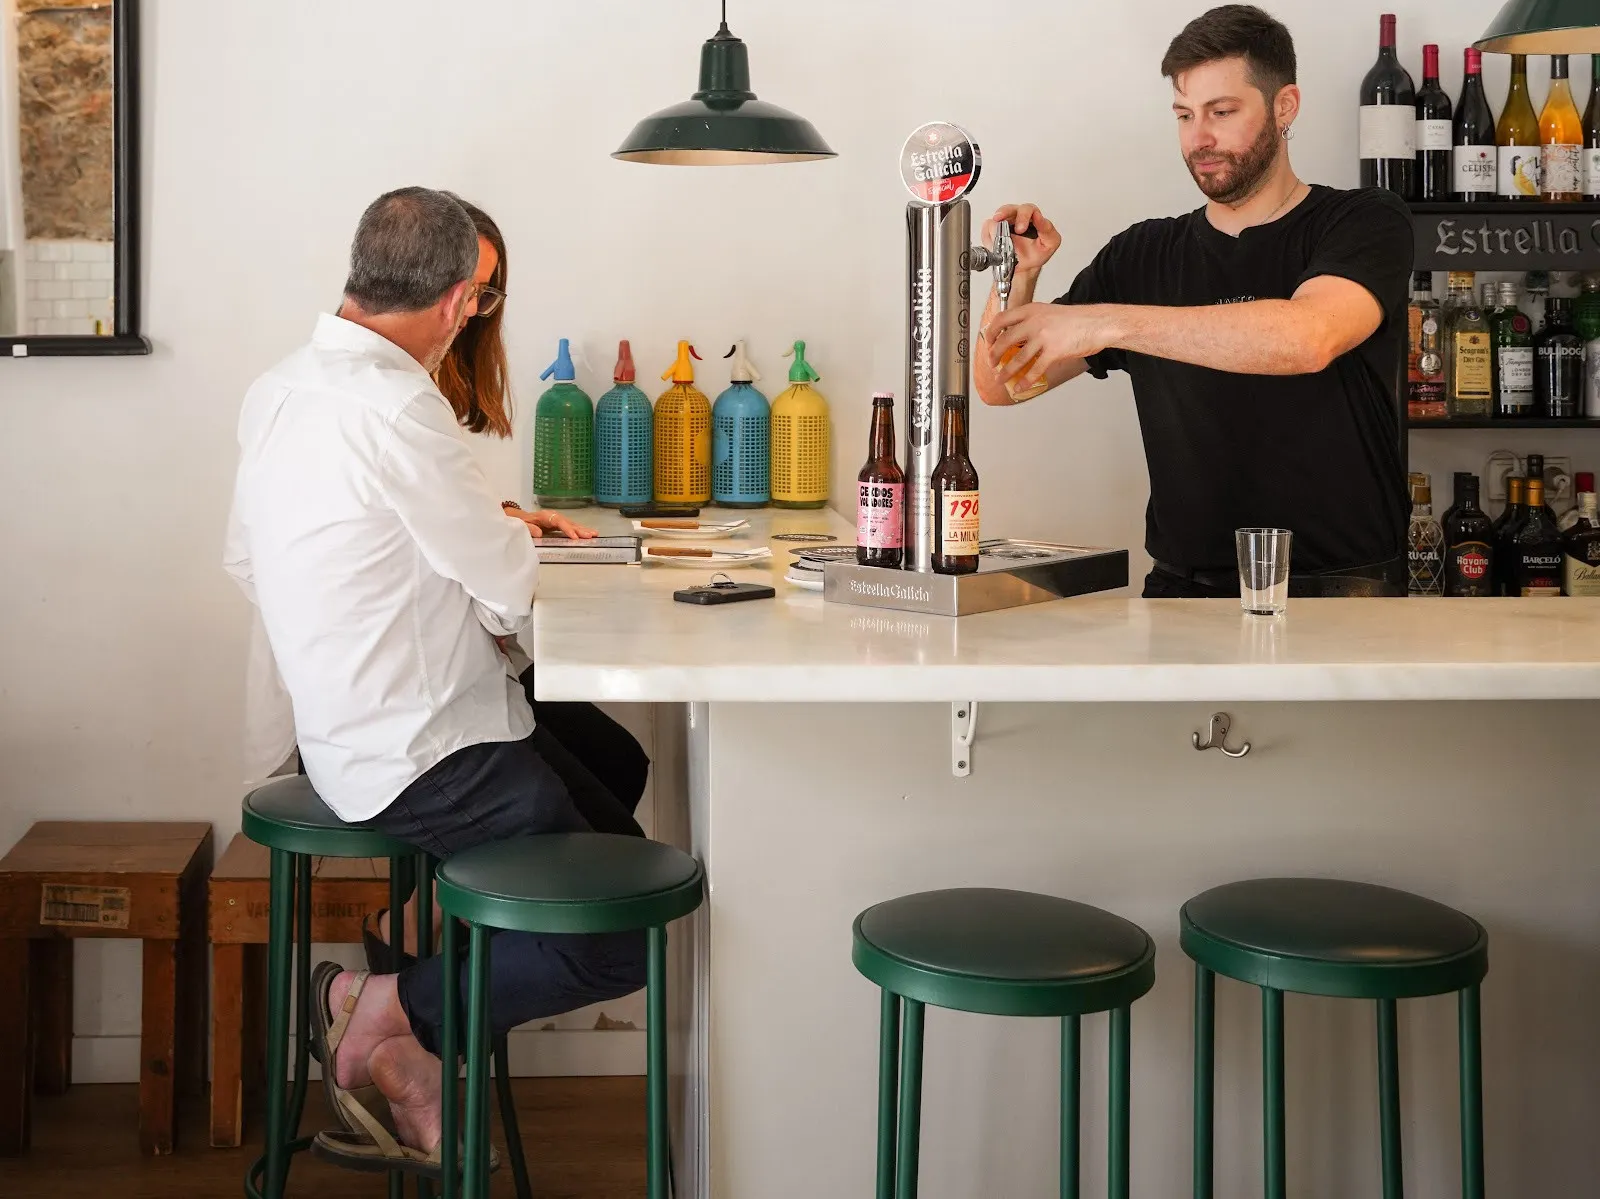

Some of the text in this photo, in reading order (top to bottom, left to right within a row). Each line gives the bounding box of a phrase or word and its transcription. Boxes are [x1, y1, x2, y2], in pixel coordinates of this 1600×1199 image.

[910, 145, 963, 170] Estrella
[913, 159, 964, 182] Galicia
[1435, 218, 1582, 255] Estrella
[949, 531, 958, 539] LA
[1456, 555, 1489, 566] Havana
[1522, 554, 1561, 565] BARCELÓ
[1463, 564, 1484, 574] Club
[849, 579, 929, 602] Estrella Galicia
